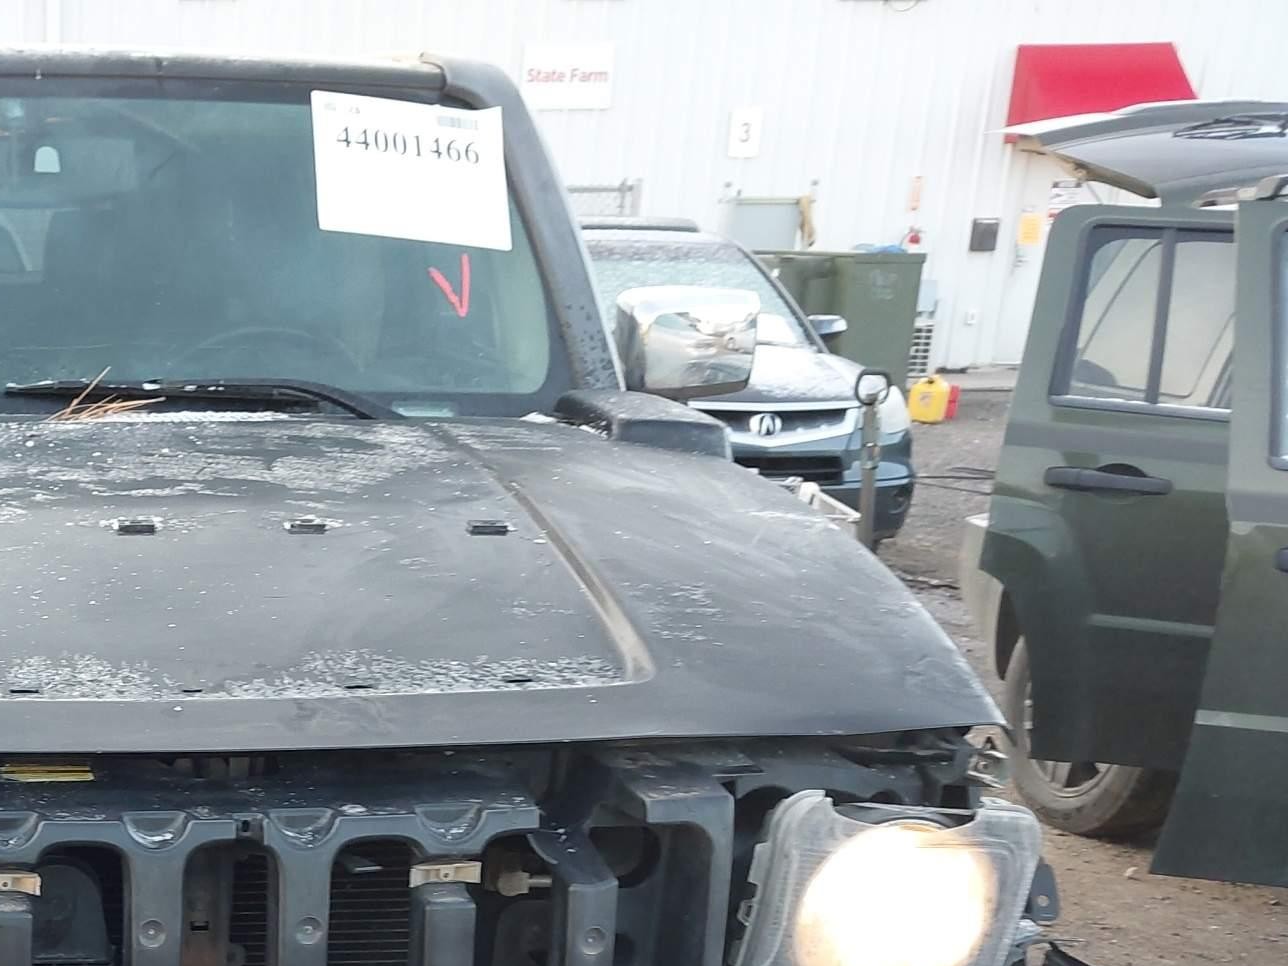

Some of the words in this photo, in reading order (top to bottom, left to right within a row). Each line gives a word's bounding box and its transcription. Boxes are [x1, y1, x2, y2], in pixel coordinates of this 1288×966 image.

[527, 67, 565, 83] State
[570, 67, 609, 83] Farm
[738, 122, 752, 143] 3
[336, 126, 480, 164] 44001466
